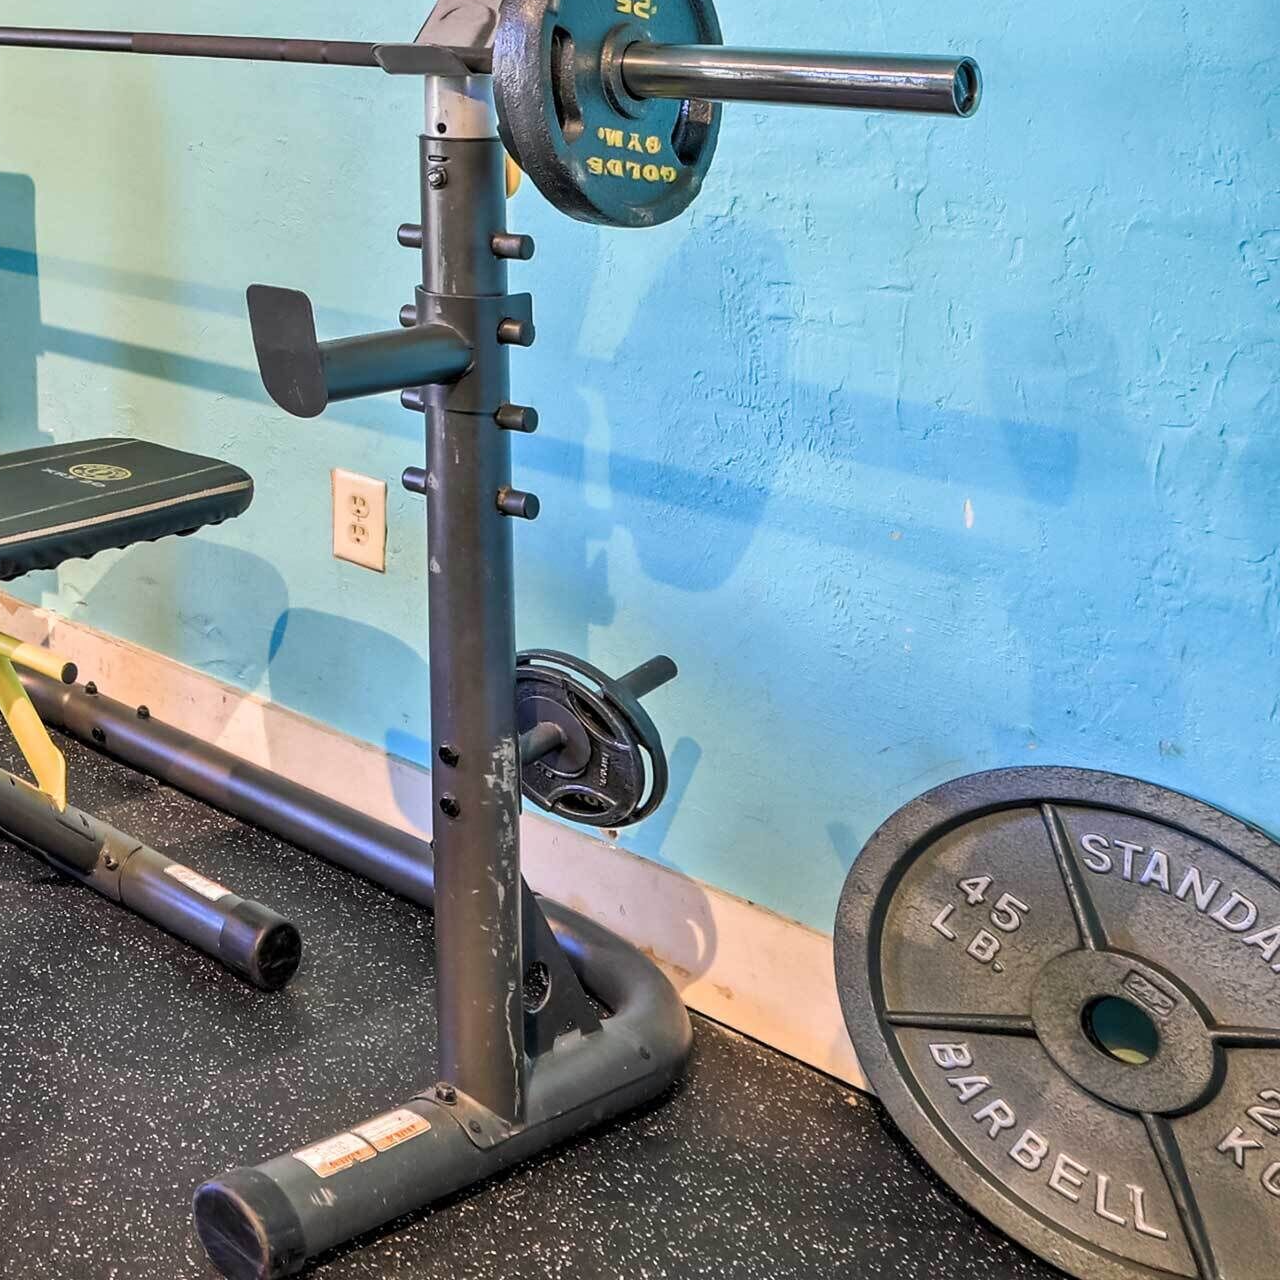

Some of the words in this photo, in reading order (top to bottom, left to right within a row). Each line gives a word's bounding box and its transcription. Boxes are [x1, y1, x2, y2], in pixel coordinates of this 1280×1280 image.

[929, 902, 1006, 974] LB.
[956, 873, 1031, 933] 45
[1081, 832, 1280, 975] STANDA
[928, 1040, 1169, 1242] BARBELL
